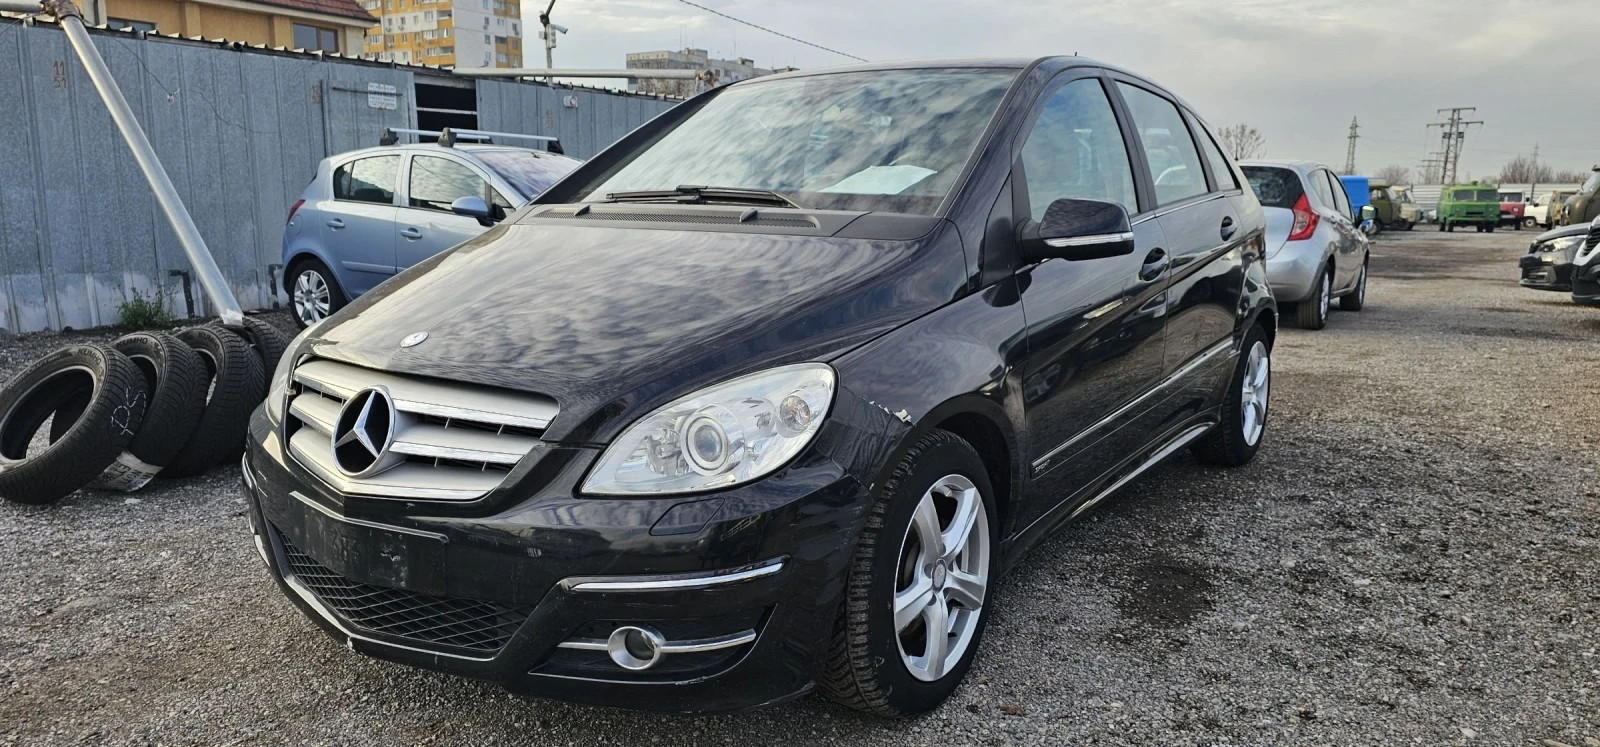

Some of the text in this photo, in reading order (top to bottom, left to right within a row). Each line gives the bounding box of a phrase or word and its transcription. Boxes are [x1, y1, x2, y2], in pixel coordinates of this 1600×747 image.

[53, 60, 65, 75] 11
[54, 77, 67, 88] 51
[115, 337, 149, 350] KUMHO
[77, 347, 102, 366] KUMHO
